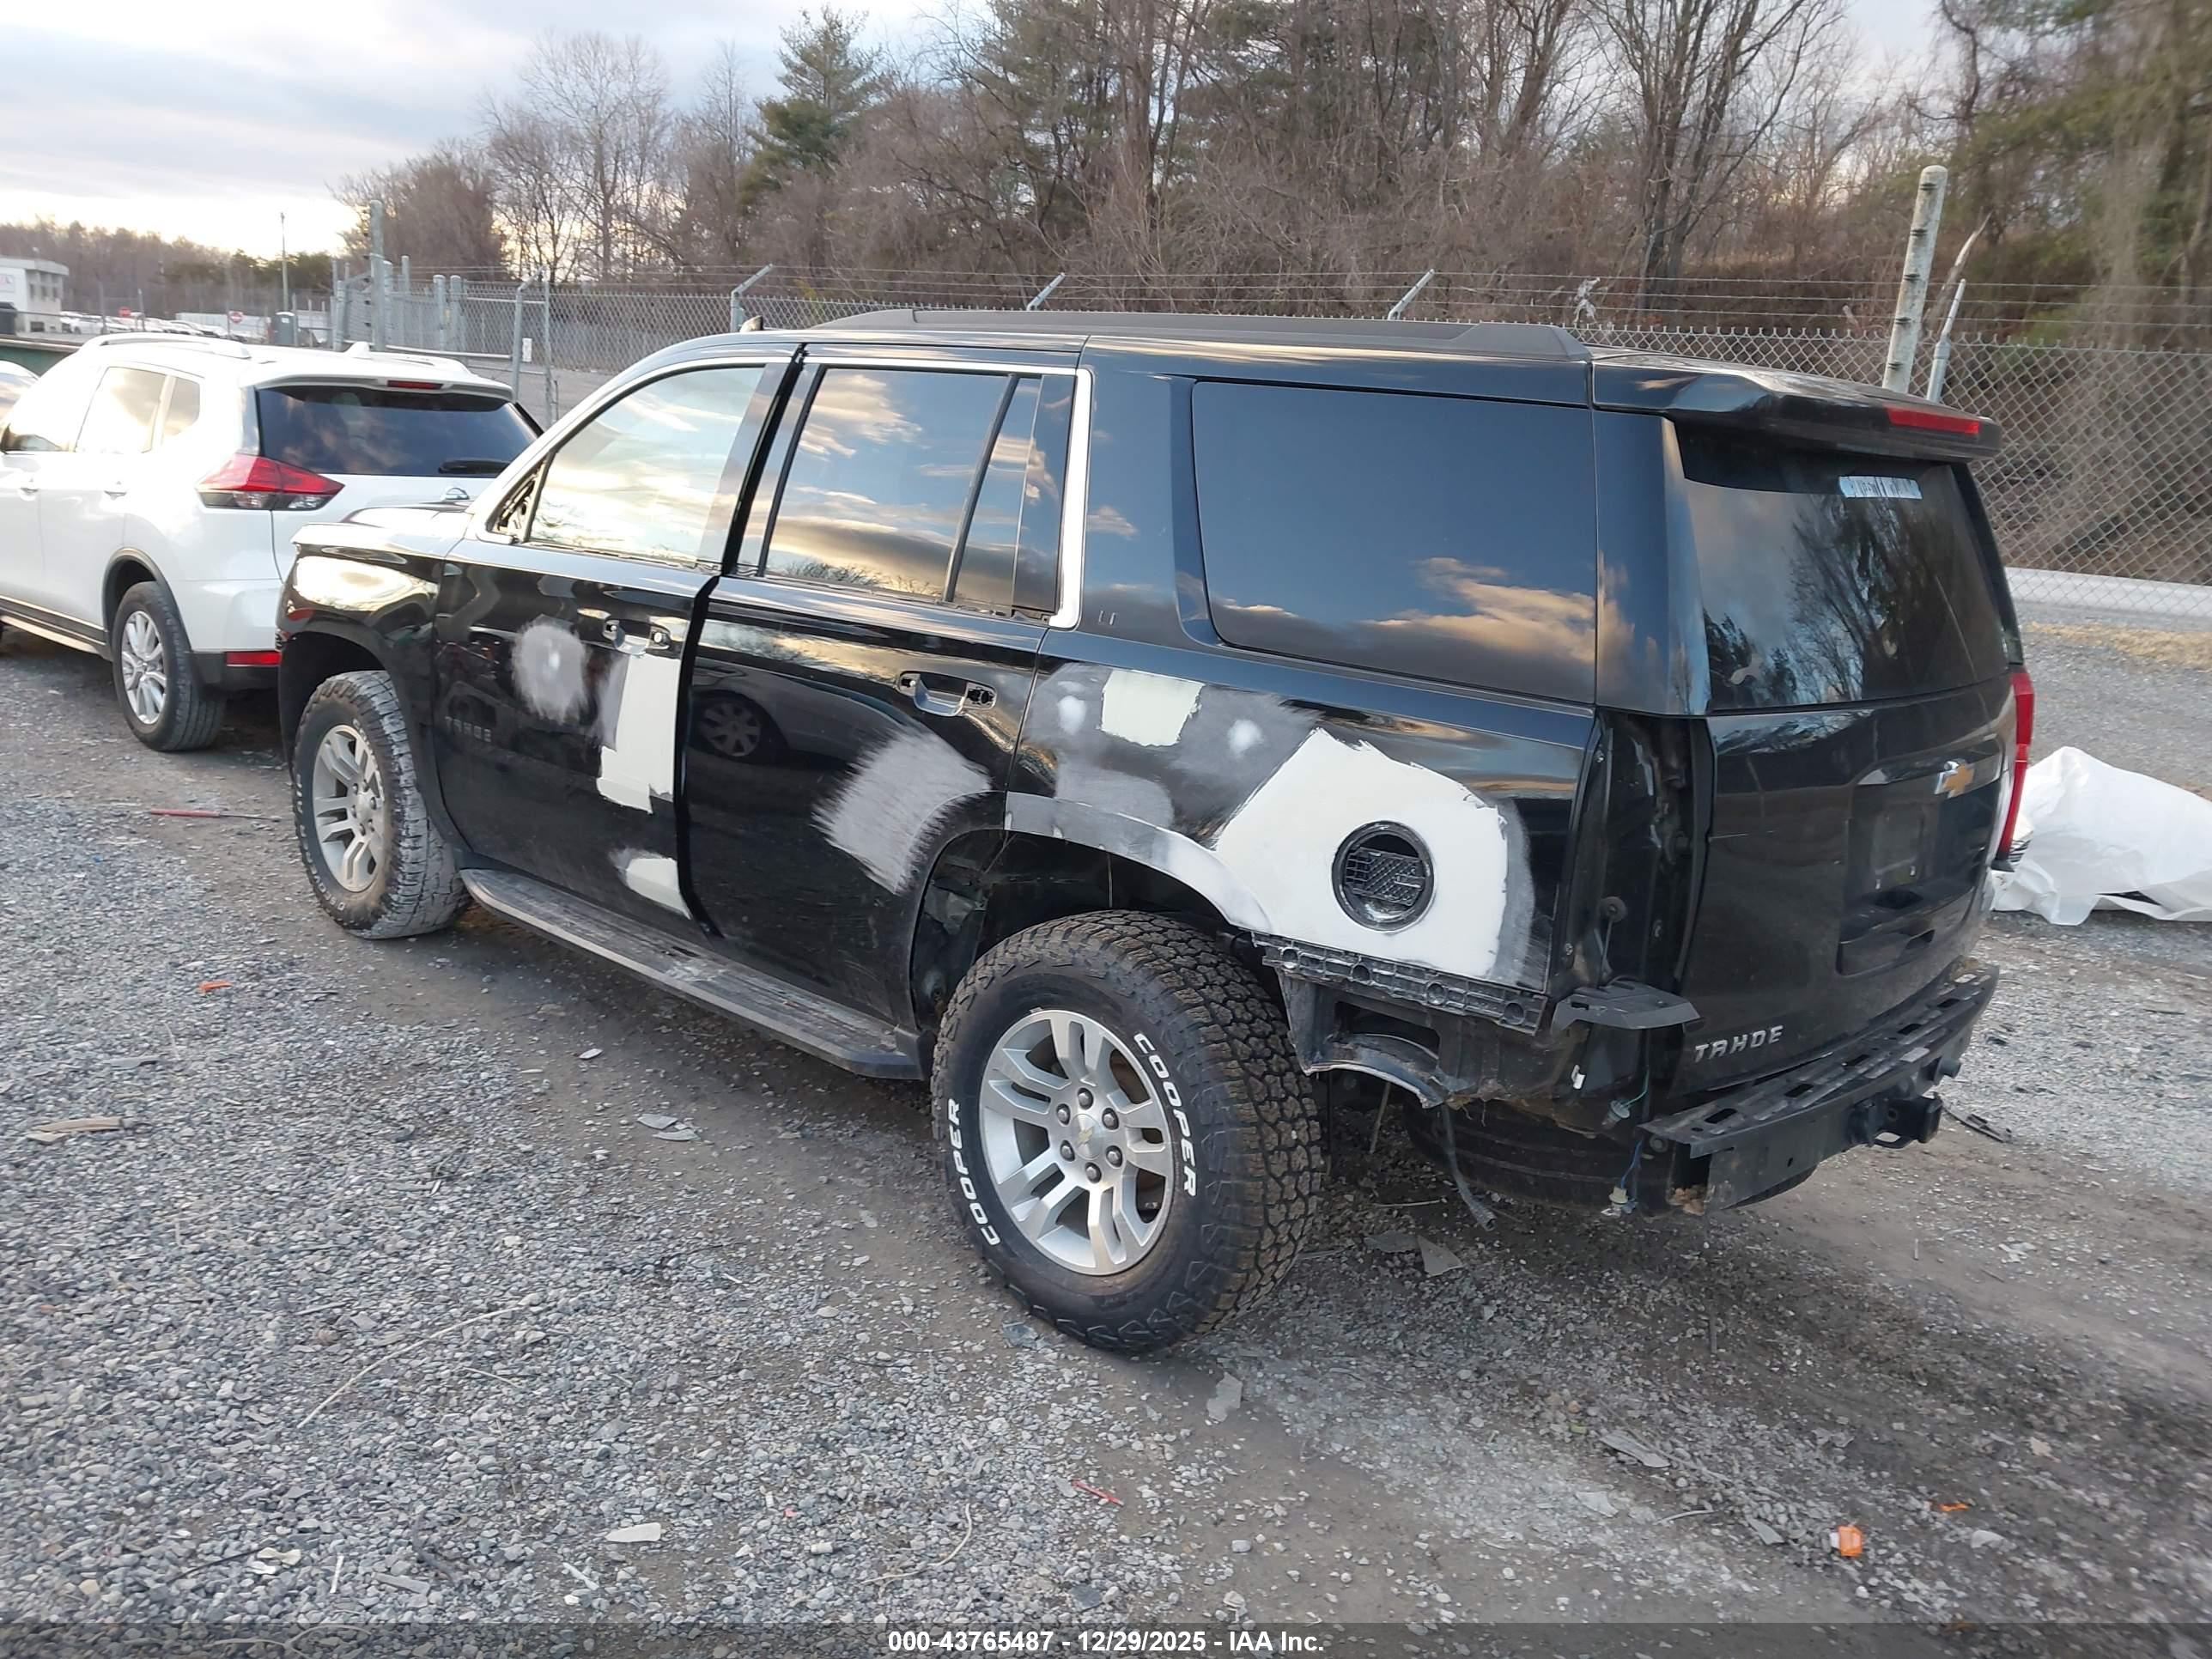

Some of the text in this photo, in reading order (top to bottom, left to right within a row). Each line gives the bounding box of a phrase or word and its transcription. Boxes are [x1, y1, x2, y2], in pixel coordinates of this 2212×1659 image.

[1133, 1033, 1197, 1197] COOPER
[1695, 1025, 1784, 1063] TAHOE
[948, 1098, 1001, 1246] COOPER
